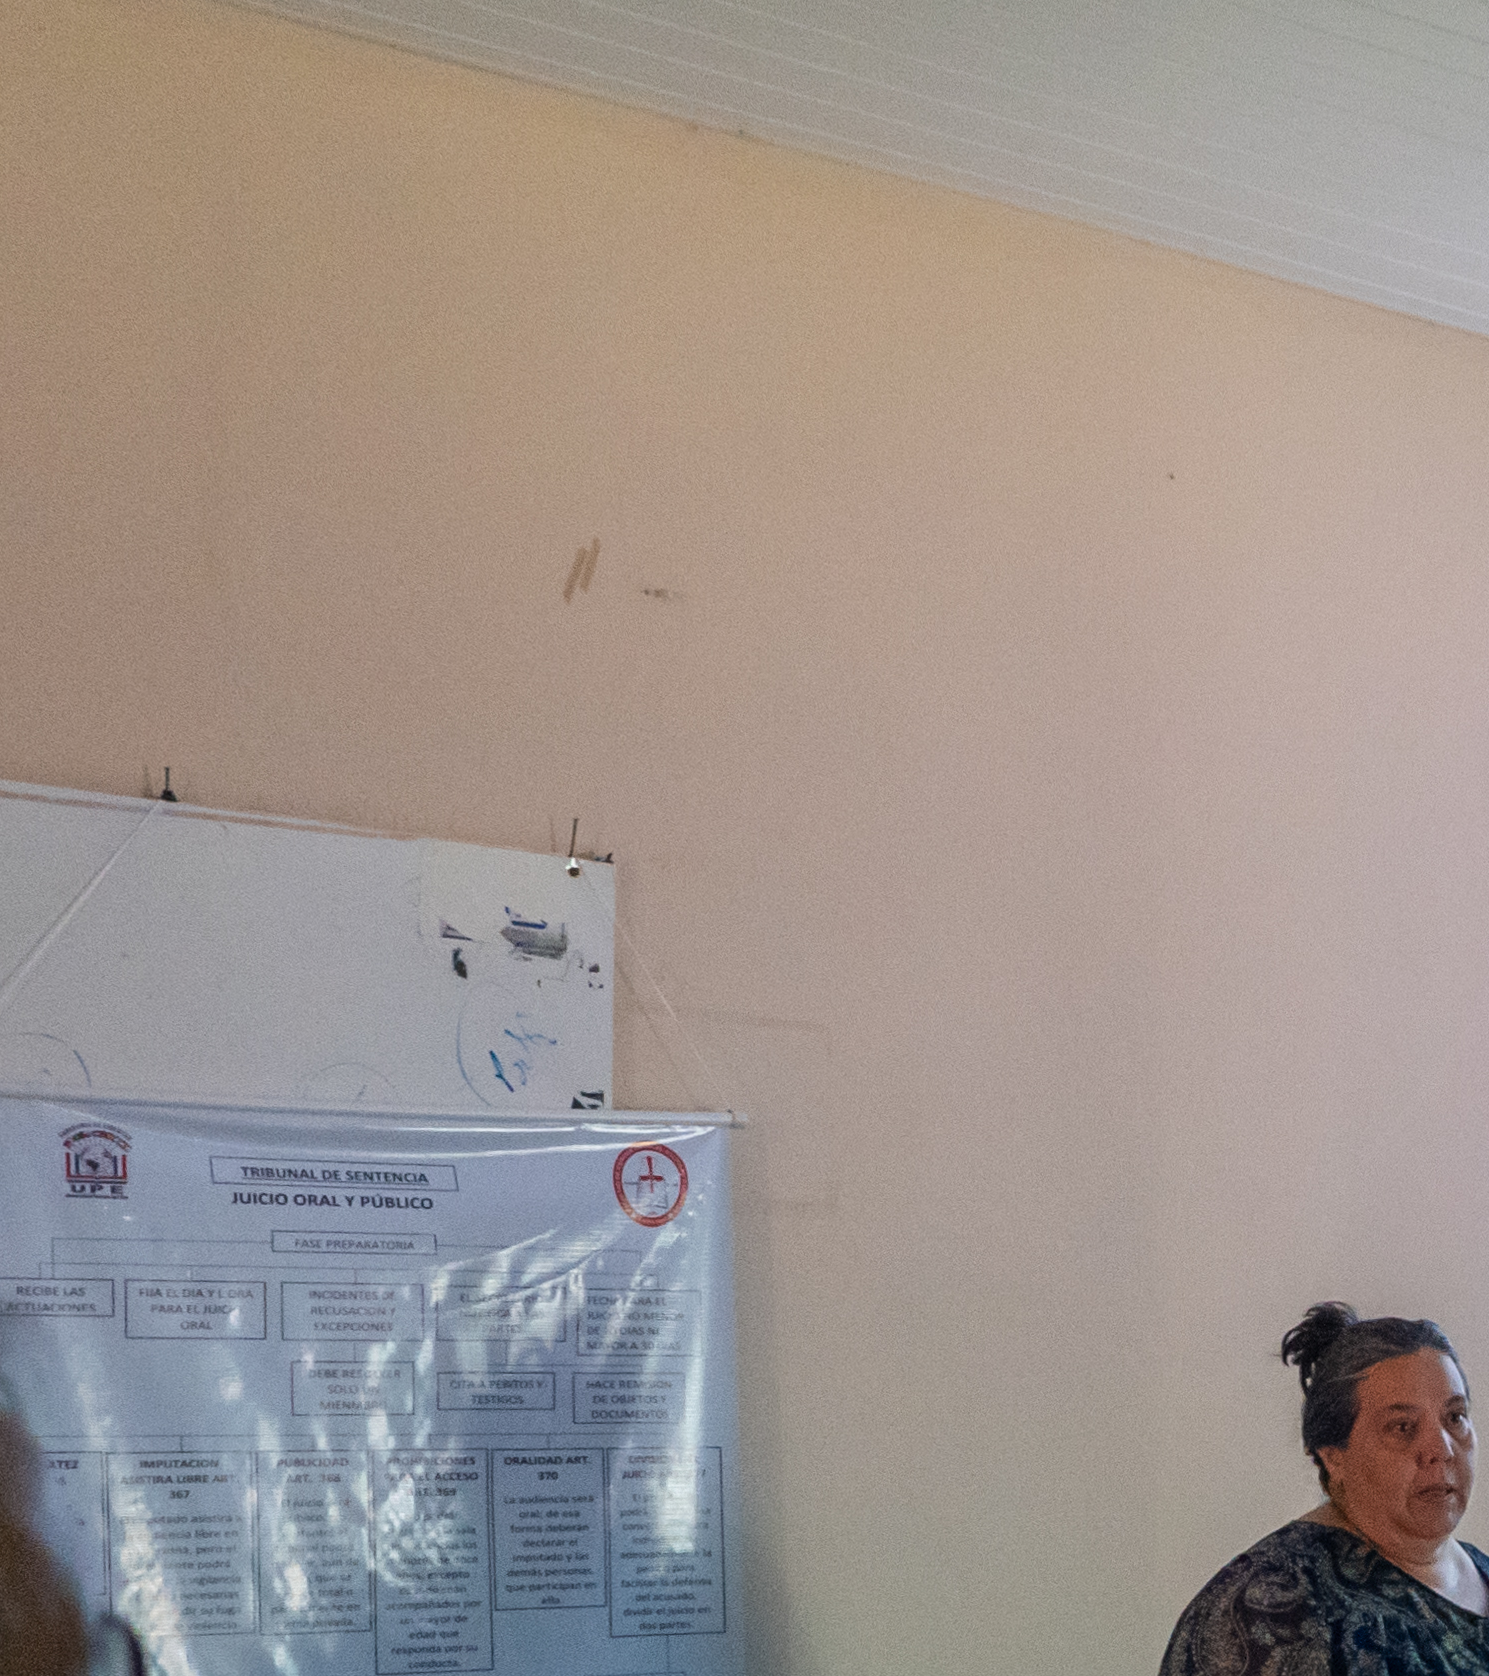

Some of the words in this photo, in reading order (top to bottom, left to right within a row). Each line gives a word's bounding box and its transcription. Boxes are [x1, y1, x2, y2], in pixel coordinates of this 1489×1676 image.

[241, 1166, 318, 1181] TRIBUNAL
[321, 1169, 342, 1181] DE
[345, 1169, 429, 1184] SENTENCIA
[69, 1184, 124, 1196] UPE
[232, 1192, 288, 1206] JUICIO
[293, 1194, 340, 1207] ORAL
[344, 1196, 355, 1208] Y
[360, 1193, 434, 1210] PÚBLICO
[295, 1238, 322, 1249] FASE
[325, 1239, 415, 1251] PREPARATORIA
[16, 1286, 60, 1297] RECIBE
[63, 1287, 86, 1297] LAS
[309, 1290, 379, 1301] INCIDENTES
[151, 1304, 183, 1314] PARA
[187, 1304, 200, 1315] EL
[180, 1320, 213, 1331] ORAL
[139, 1460, 219, 1468] IMPUTACION
[277, 1458, 349, 1468] PUBLICIDAD
[504, 1455, 562, 1466] ORALIDAD
[565, 1455, 591, 1466] ART.
[177, 1474, 205, 1483] LIBRE
[538, 1471, 558, 1481] 370
[169, 1490, 190, 1500] 367
